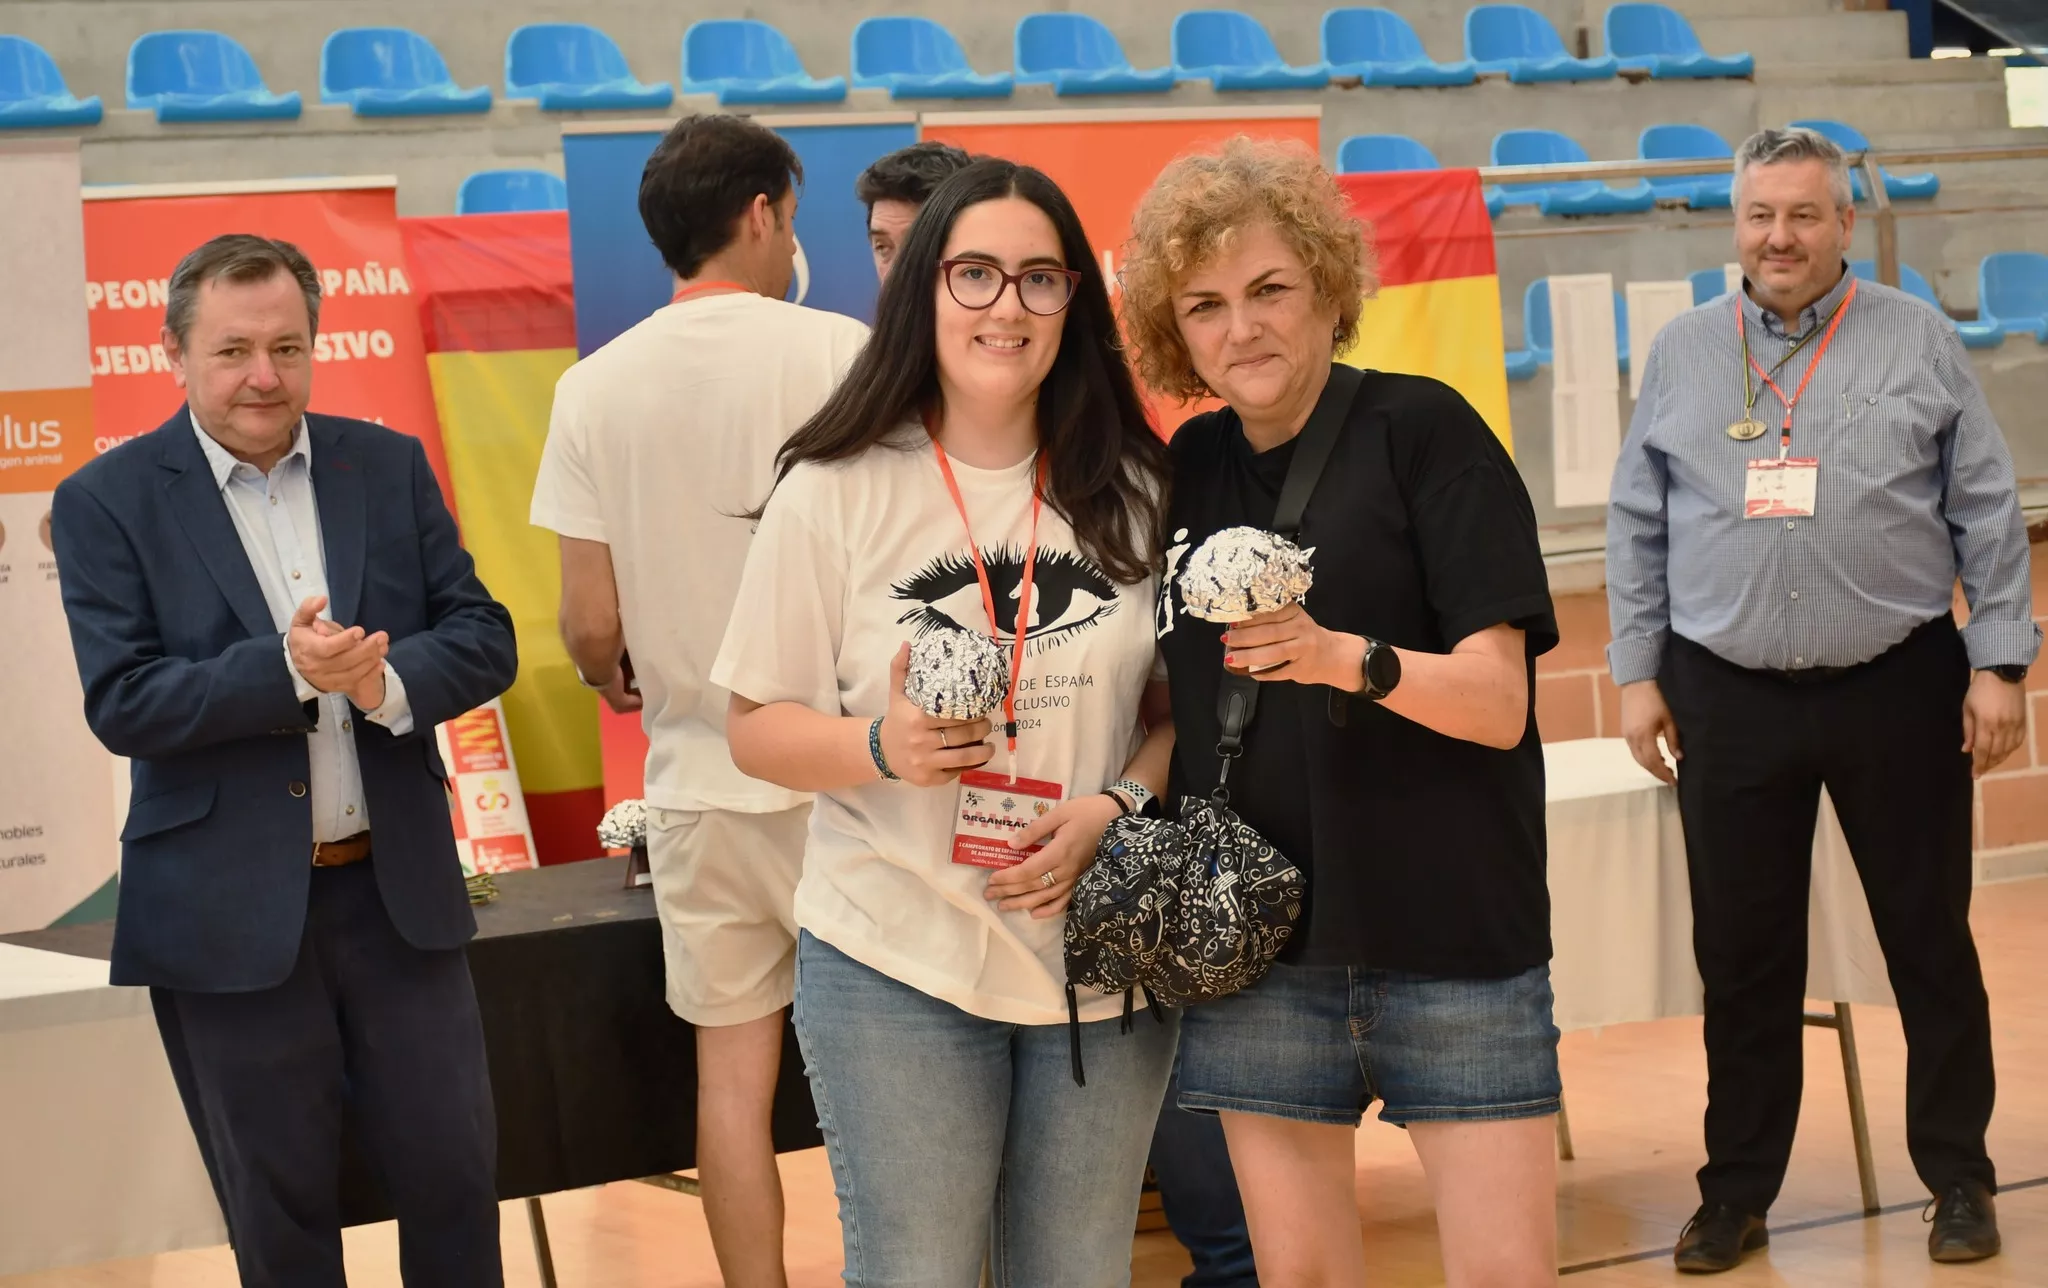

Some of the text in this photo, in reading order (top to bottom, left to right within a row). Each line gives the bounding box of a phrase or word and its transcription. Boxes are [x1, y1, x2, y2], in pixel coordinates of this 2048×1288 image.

[86, 278, 169, 310] PEON
[314, 329, 395, 363] SIVO
[0, 414, 62, 450] lus
[0, 452, 63, 469] gen animal
[1019, 674, 1094, 691] DE ESPAÑA
[1014, 719, 1042, 731] 2024
[962, 814, 1028, 829] ORGANIZAC
[962, 842, 994, 851] CAMPEONATO
[0, 853, 47, 870] urales
